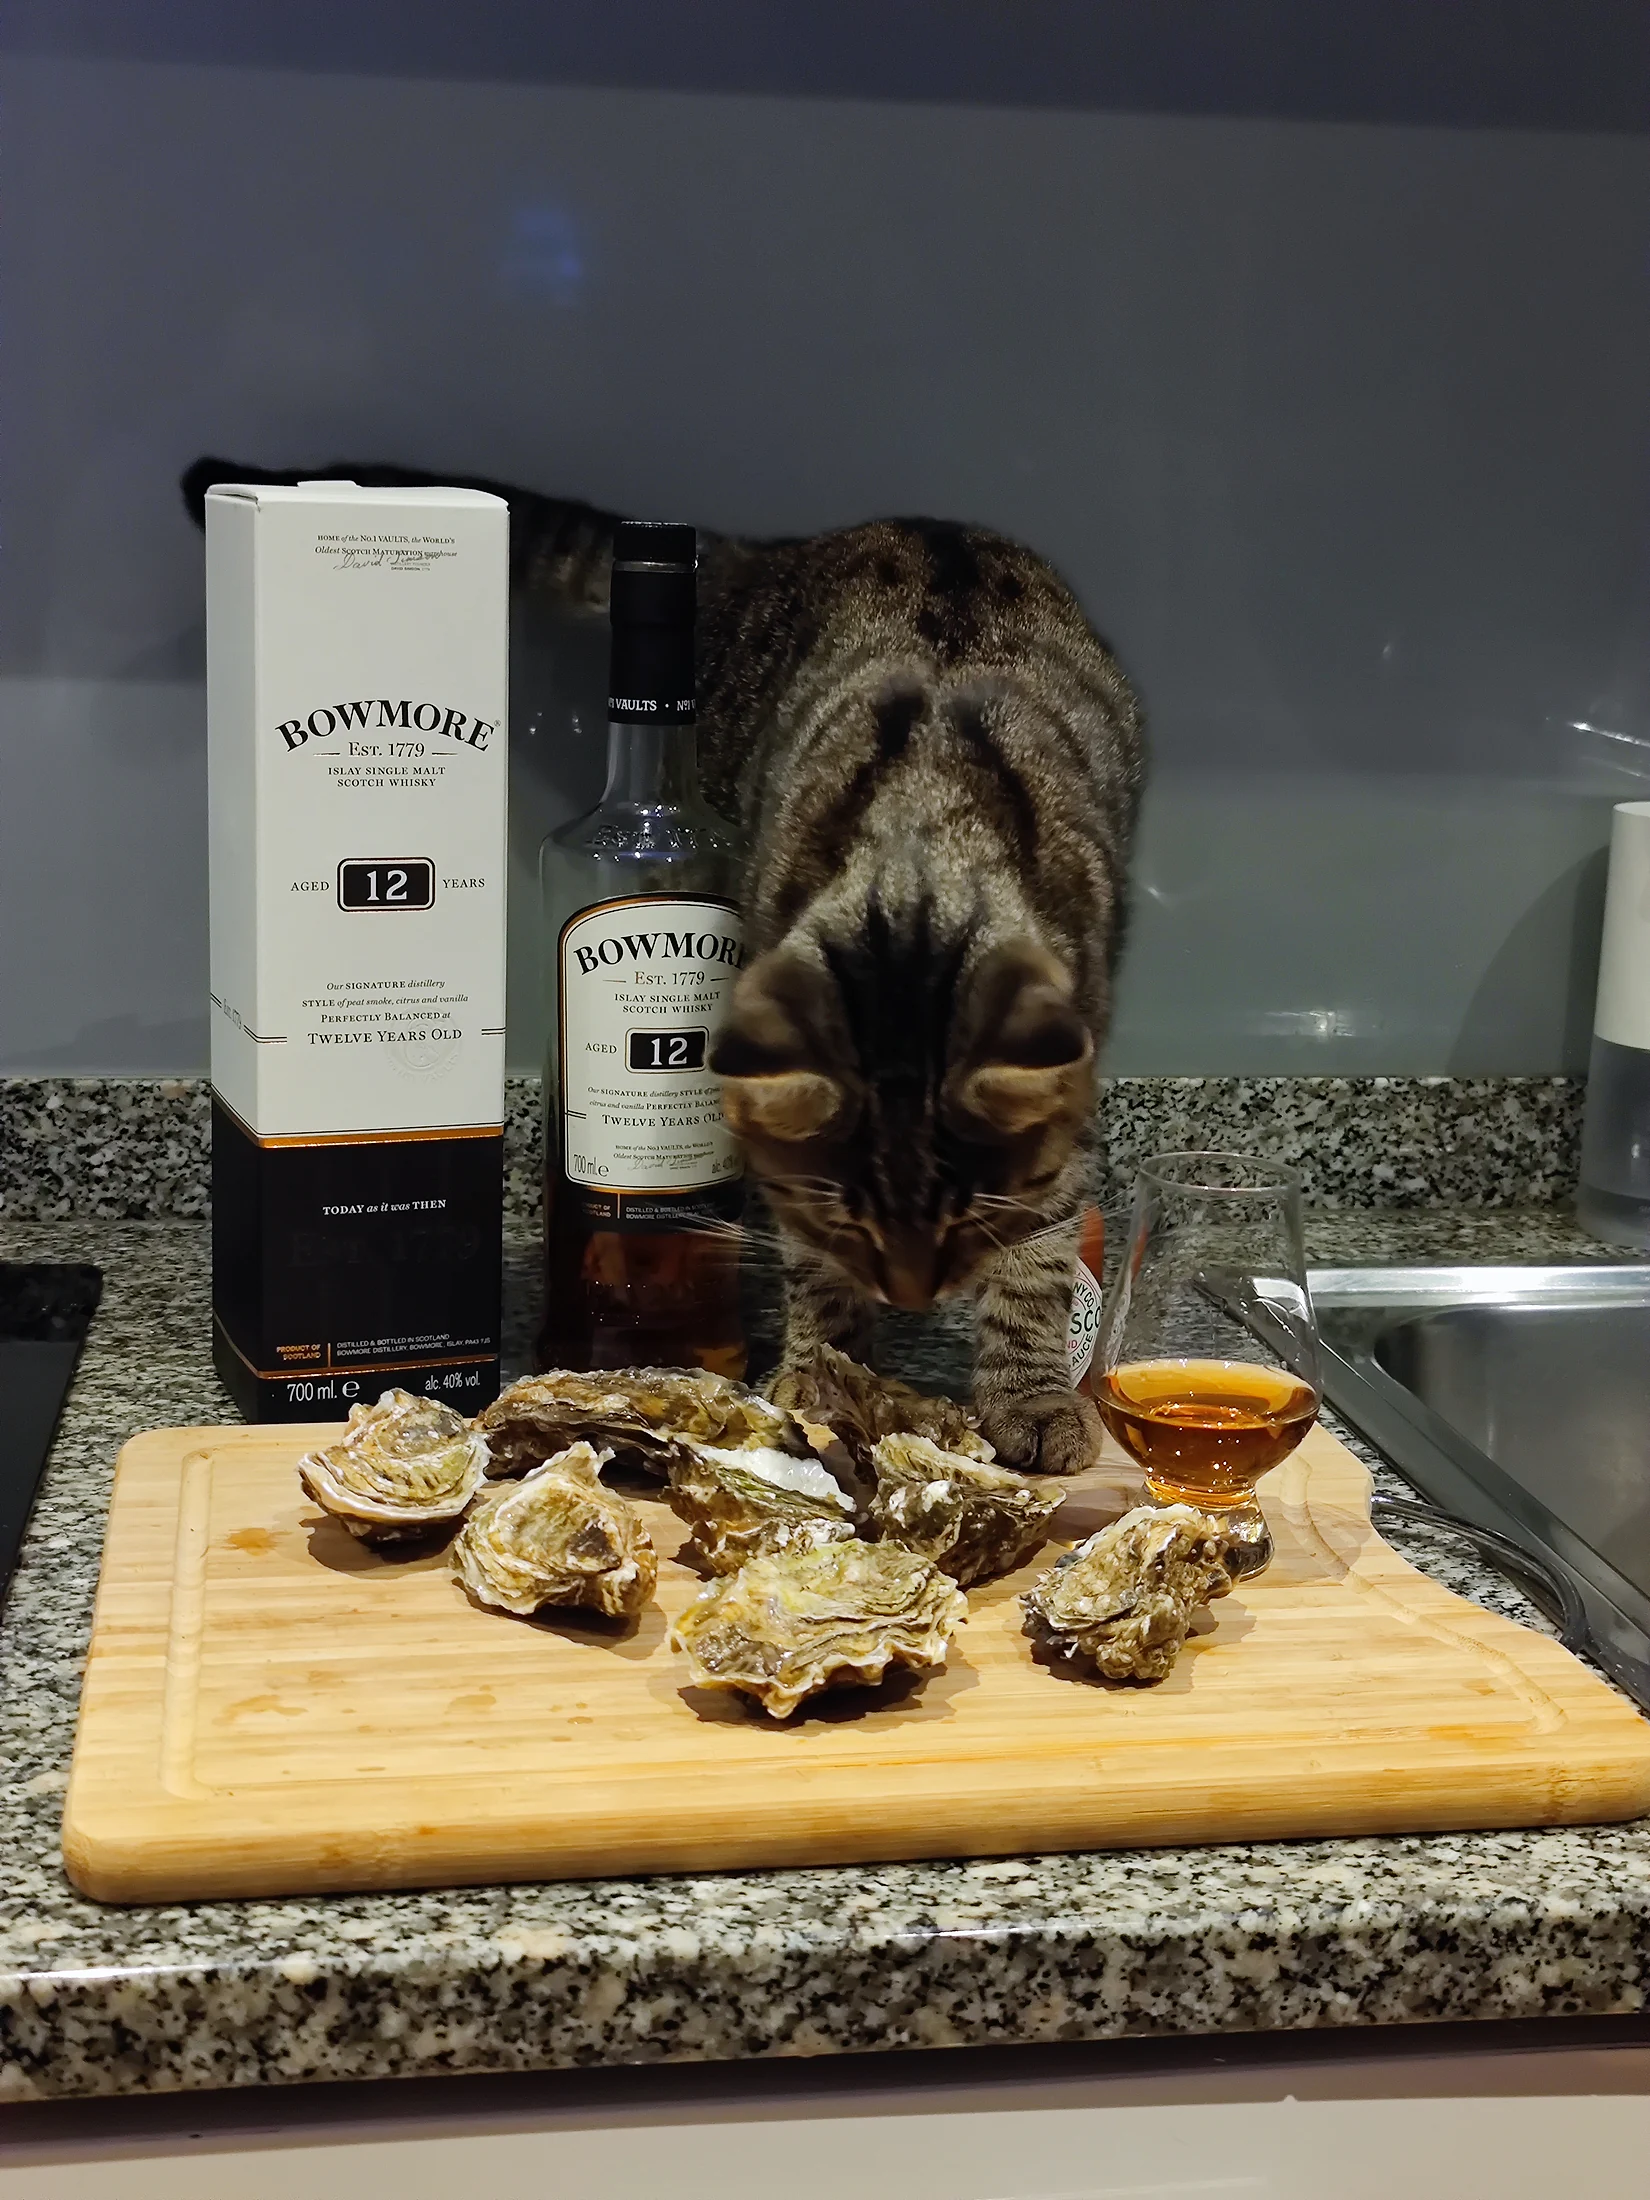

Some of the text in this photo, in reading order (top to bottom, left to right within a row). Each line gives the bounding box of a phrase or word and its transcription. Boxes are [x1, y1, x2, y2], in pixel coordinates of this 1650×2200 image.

[315, 546, 339, 554] Oldest
[341, 547, 371, 555] SCOTCH
[615, 697, 657, 711] VAULTS
[388, 743, 425, 758] 1779
[328, 767, 446, 775] ISLAY SINGLE MALT
[337, 779, 436, 787] SCOTCH WHISKY
[290, 881, 330, 891] AGED
[367, 869, 408, 901] 12
[443, 878, 485, 889] YEARS
[327, 979, 445, 990] Our SIGNATURE distillery
[672, 971, 705, 986] 1779
[302, 994, 469, 1008] STYLE of peat smoke, citrus and vanilla
[614, 991, 720, 1003] ISLAY SINGLE MALT
[623, 1003, 713, 1014] SCOTCH WHISKY
[321, 1011, 451, 1023] PERFECTLY BALANCED at
[308, 1028, 462, 1044] TWELVE YEARS OLD
[585, 1042, 617, 1054] AGED
[651, 1037, 688, 1065] 12
[600, 1088, 648, 1097] SIGNATURE
[650, 1090, 678, 1098] distillery
[680, 1088, 703, 1096] STYLE
[646, 1102, 692, 1110] PERFECTLY
[602, 1114, 656, 1127] TWELVE
[660, 1115, 700, 1127] YEARS
[573, 1153, 587, 1174] 700
[322, 1199, 446, 1215] TODAY as it was THEN
[337, 1340, 369, 1349] DISTILLED
[415, 1333, 450, 1342] SCOTLAND
[276, 1344, 310, 1353] PRODUCT
[1070, 1333, 1093, 1368] AUCE
[425, 1375, 441, 1391] alc.
[443, 1372, 463, 1388] 40%
[287, 1382, 314, 1402] 700
